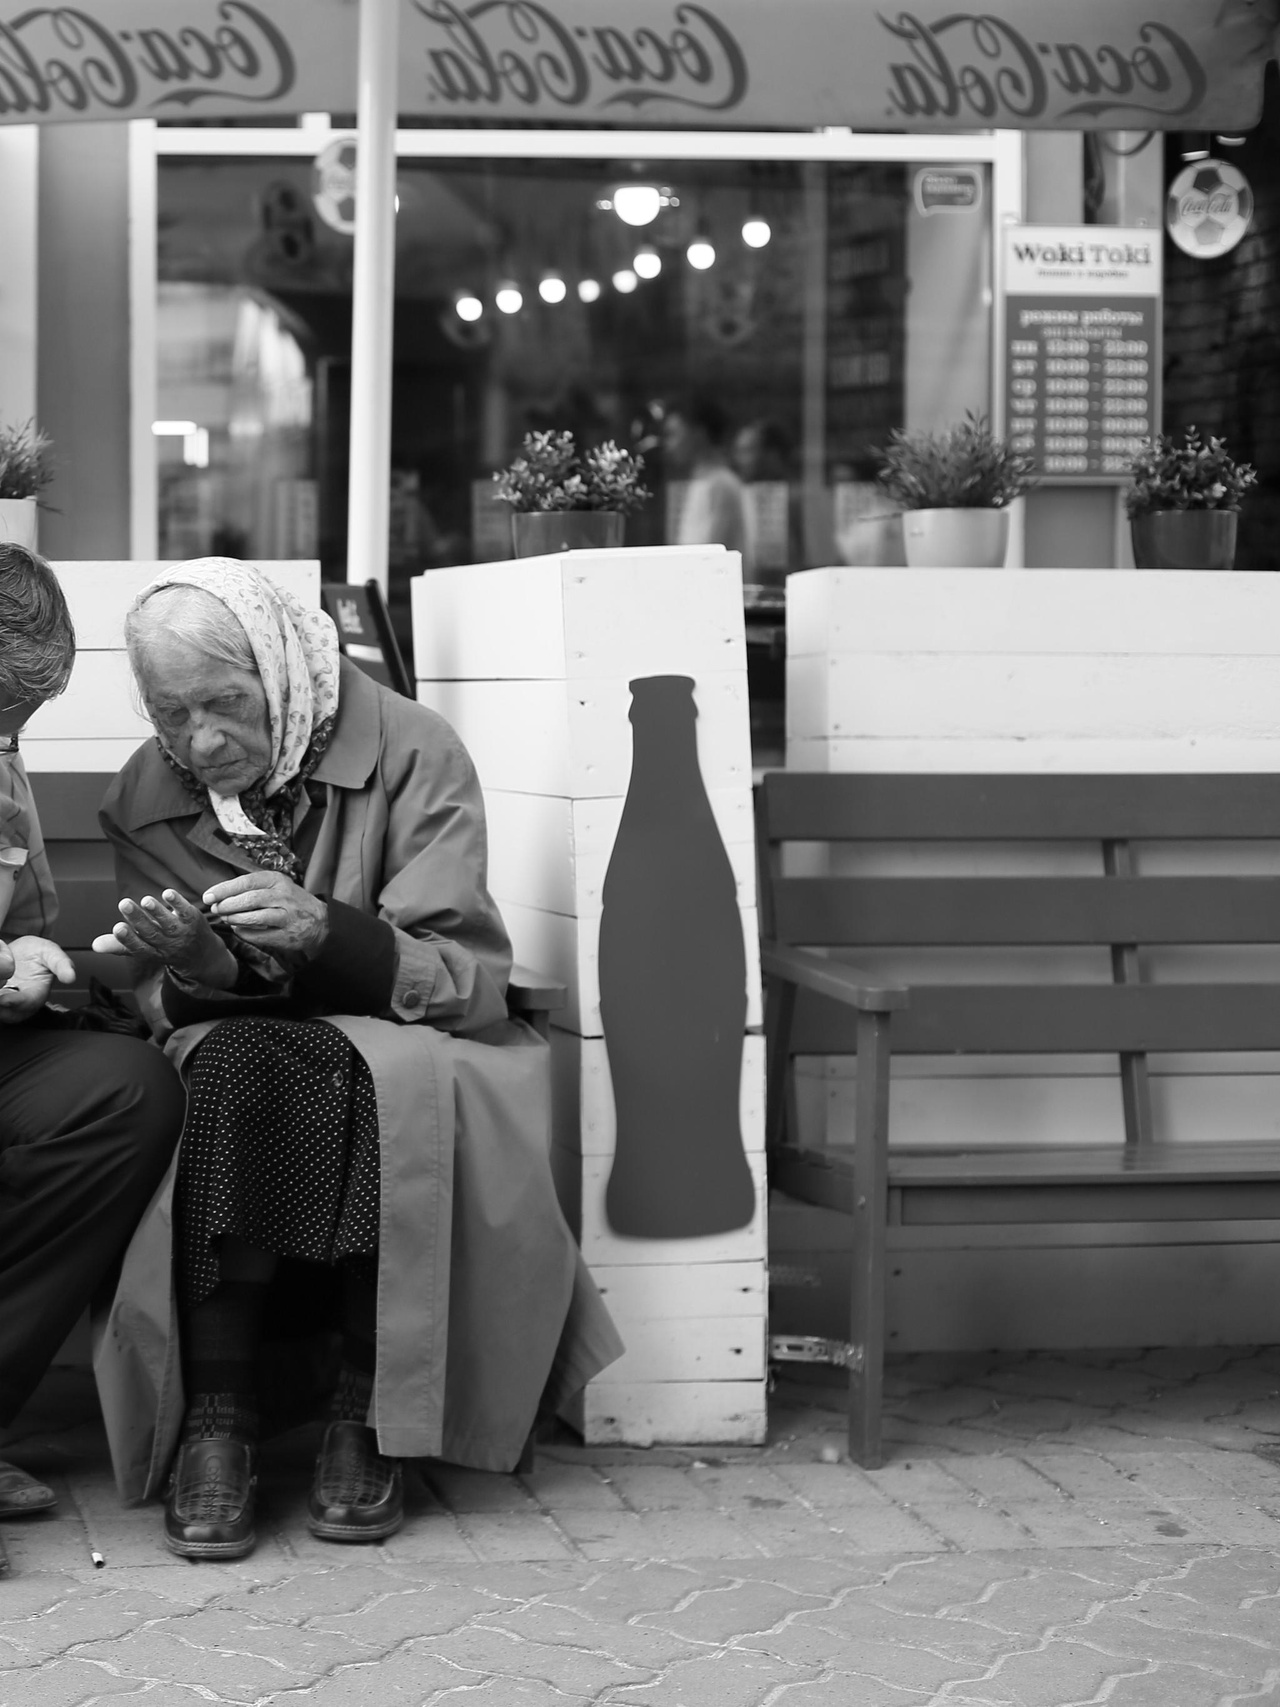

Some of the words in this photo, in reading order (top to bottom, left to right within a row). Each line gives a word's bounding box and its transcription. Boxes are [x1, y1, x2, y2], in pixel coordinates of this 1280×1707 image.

[1013, 242, 1084, 263] Woki
[1090, 243, 1151, 264] Toki
[1103, 339, 1148, 357] 22:00
[1046, 358, 1090, 376] 10:00
[1103, 359, 1148, 377] 22:00
[1045, 377, 1090, 395] 10:00
[1103, 378, 1148, 396] 22:00
[1045, 397, 1089, 414] 10:00
[1102, 398, 1148, 415] 22:00
[1044, 416, 1089, 434] 10:00
[1101, 417, 1149, 434] 00:00
[1044, 436, 1088, 453] 10:00
[1044, 455, 1088, 473] 10:00
